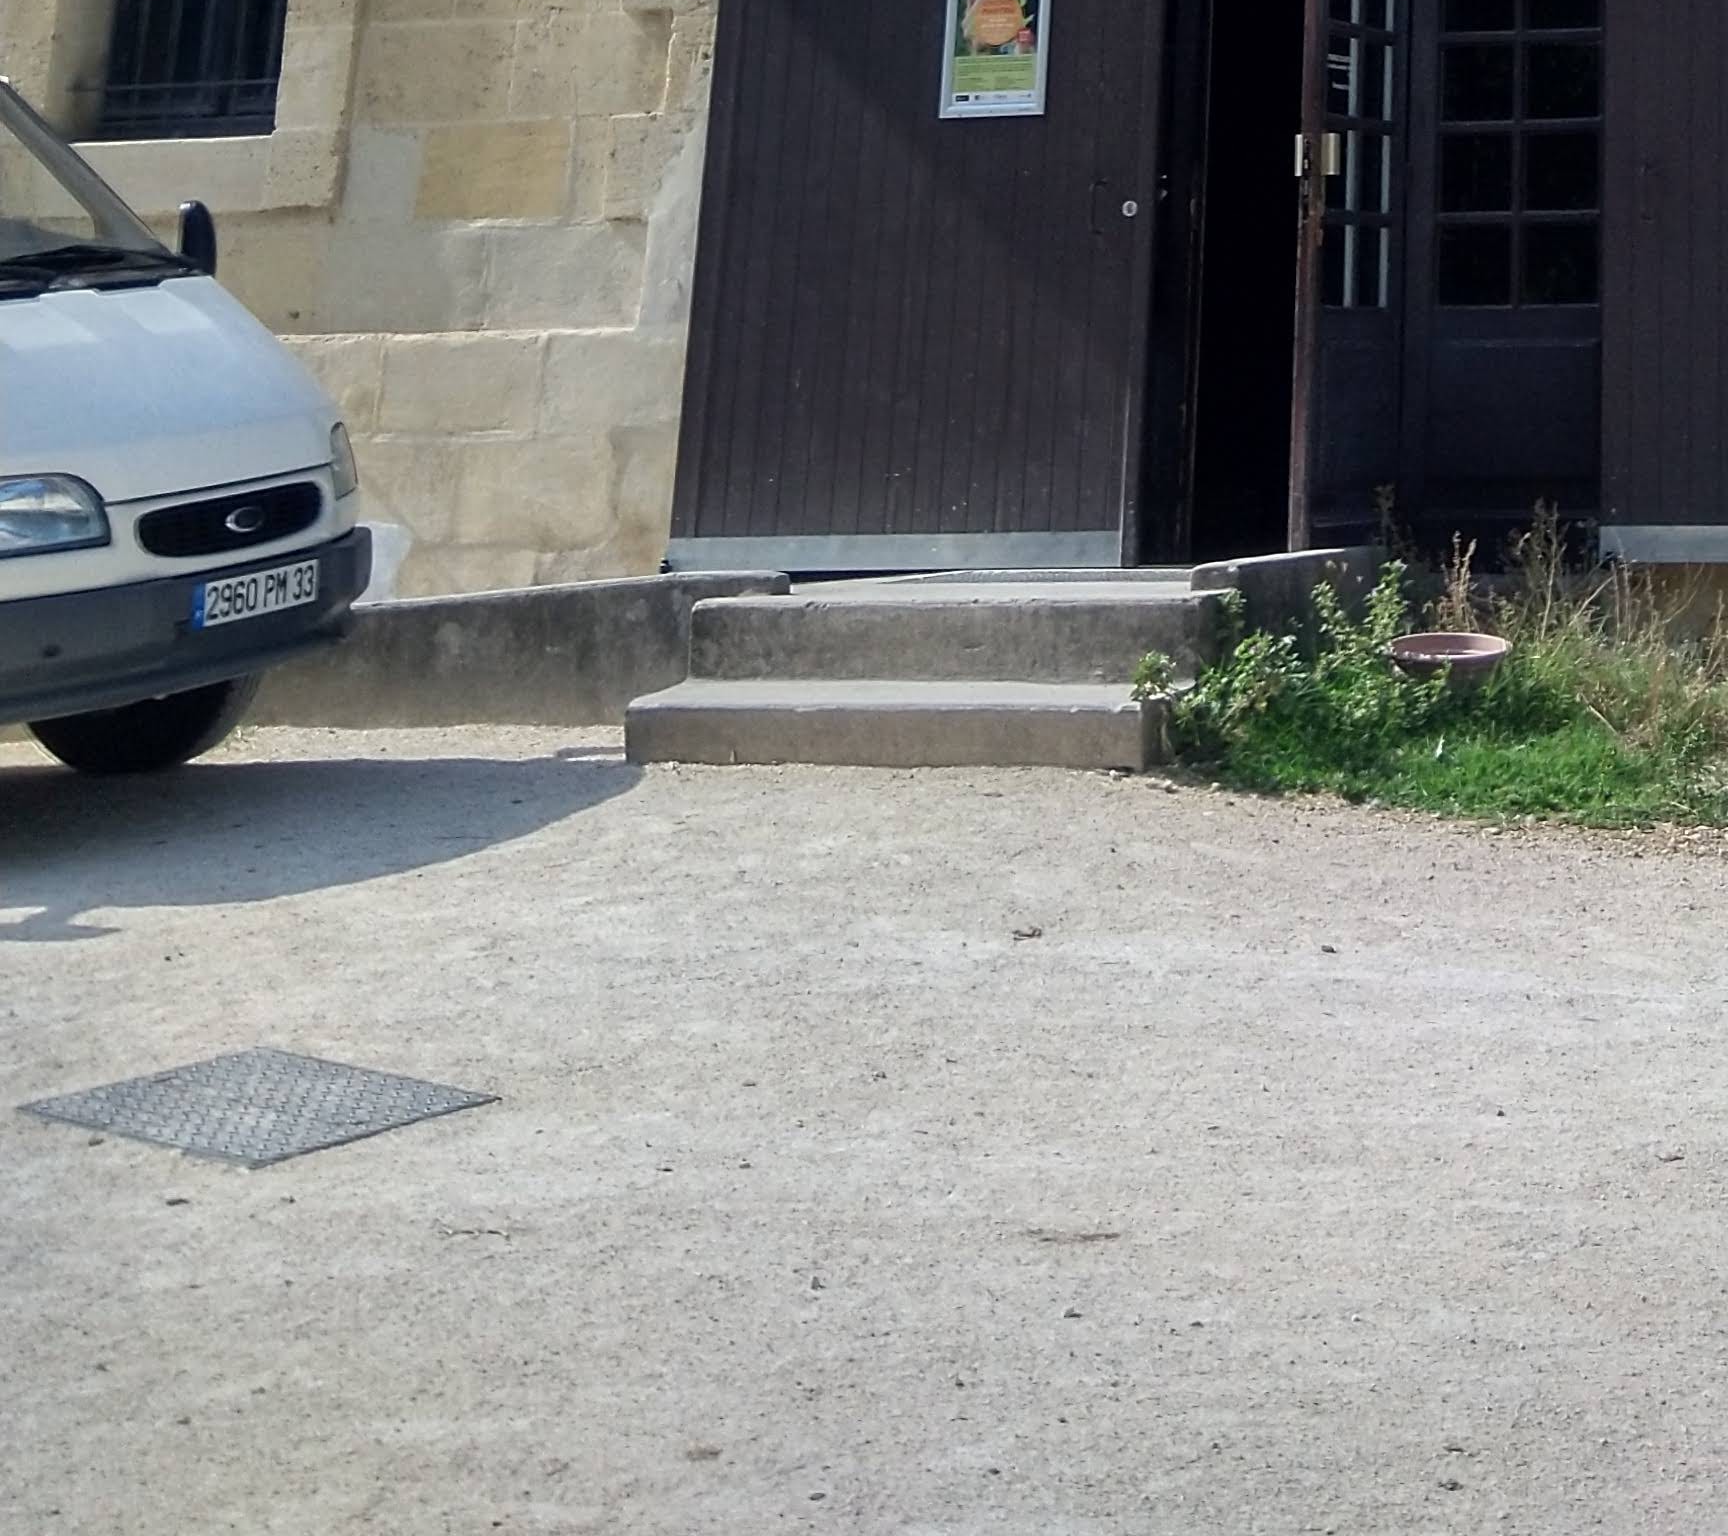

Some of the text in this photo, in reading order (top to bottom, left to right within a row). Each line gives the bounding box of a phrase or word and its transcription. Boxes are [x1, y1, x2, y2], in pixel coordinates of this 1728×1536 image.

[206, 564, 314, 621] 2960 PM 33
